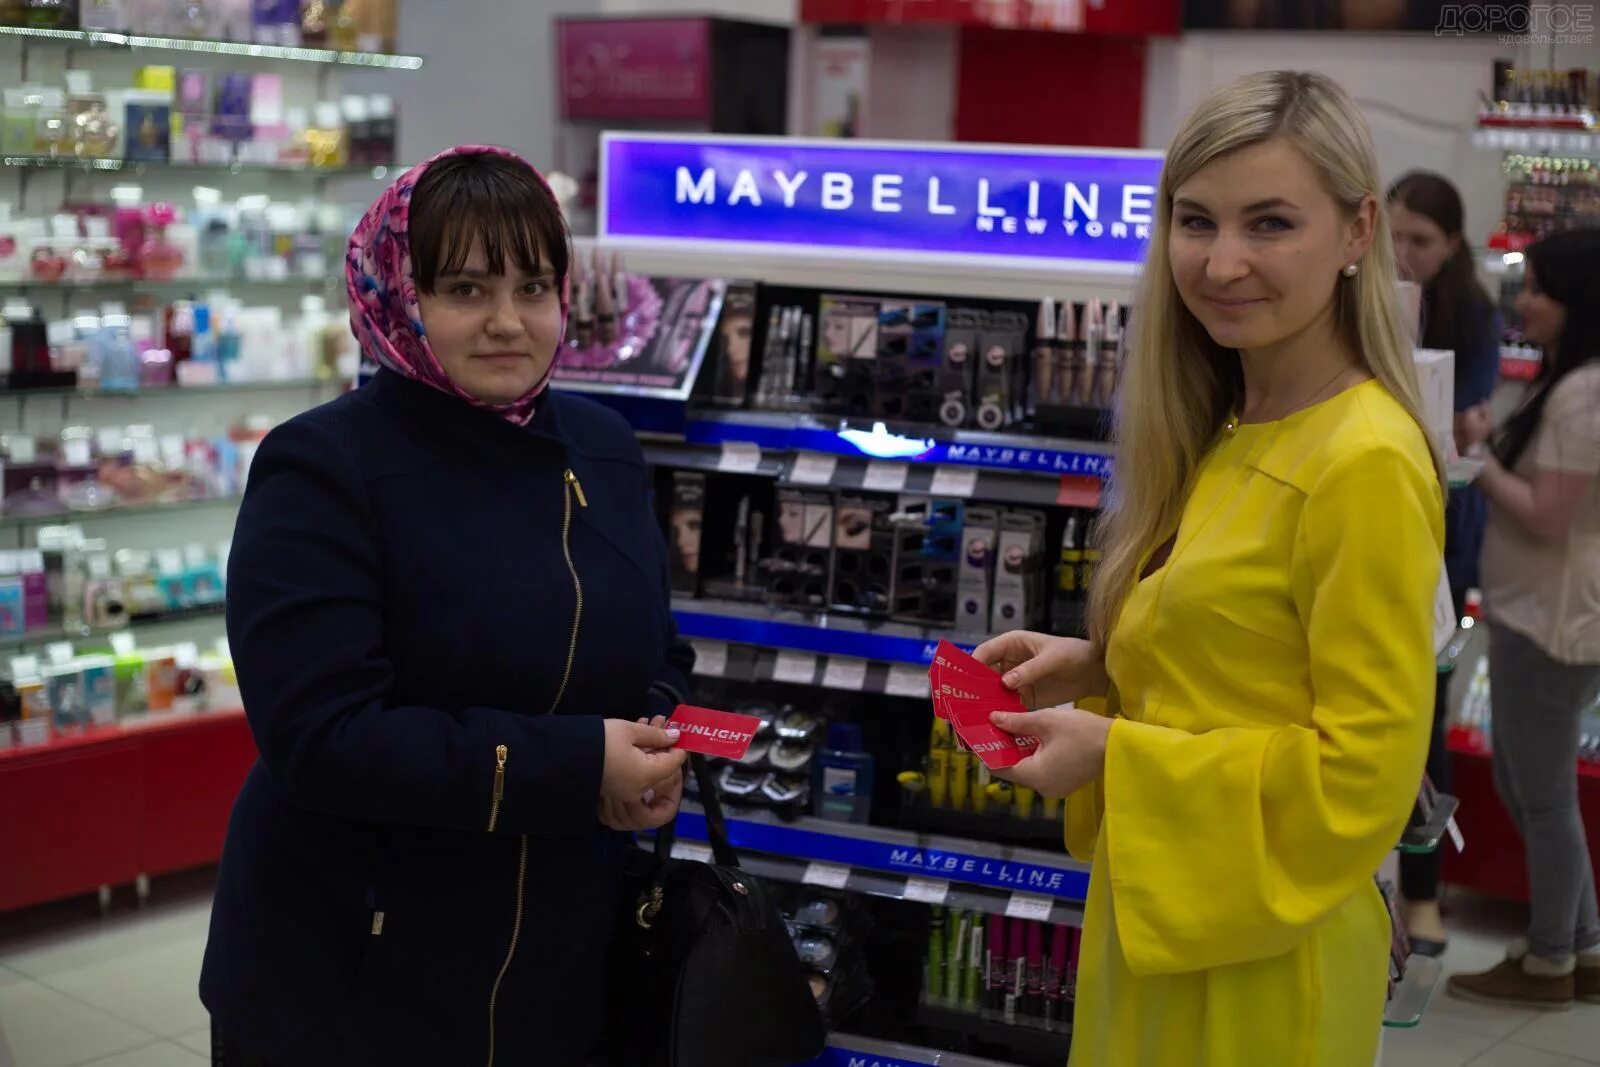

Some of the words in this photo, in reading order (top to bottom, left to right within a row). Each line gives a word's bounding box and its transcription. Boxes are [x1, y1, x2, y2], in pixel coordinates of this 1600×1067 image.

[675, 166, 1155, 223] MAYBELLINE
[976, 216, 1047, 234] NEW
[1062, 219, 1150, 239] YORK
[668, 721, 752, 742] SUNLIGHT
[890, 849, 1064, 886] MAYBELLINE
